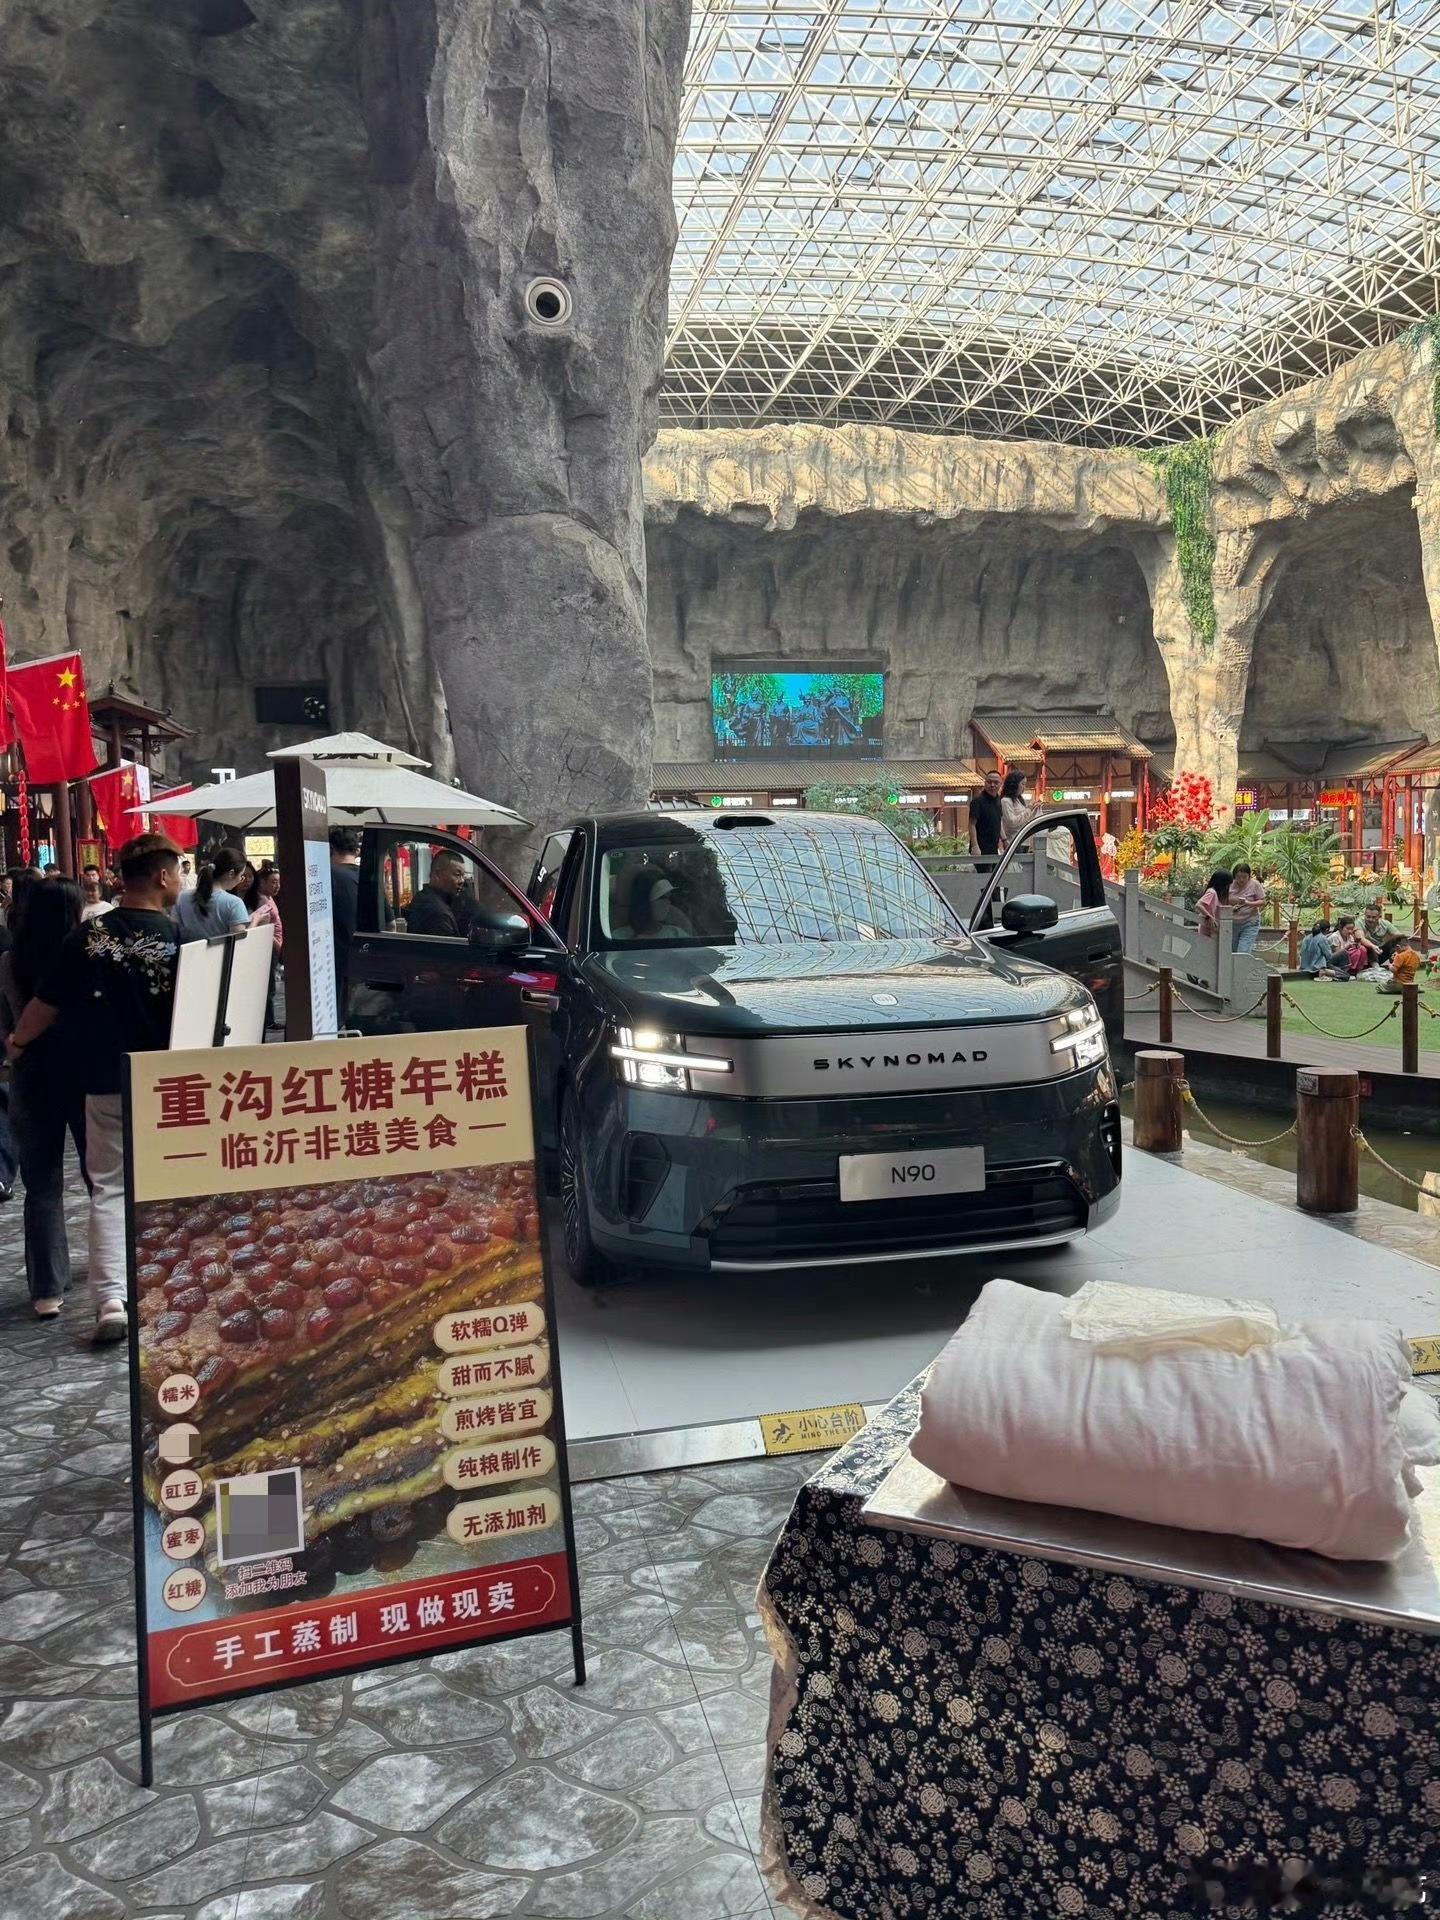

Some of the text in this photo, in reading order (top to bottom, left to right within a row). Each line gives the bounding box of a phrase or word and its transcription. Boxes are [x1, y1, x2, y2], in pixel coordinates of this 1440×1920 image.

[813, 1049, 989, 1071] SKYNOMAD
[153, 1050, 509, 1130] 重沟红糖年糕
[220, 1113, 458, 1170] 临沂非遗美食
[891, 1164, 936, 1184] N90
[450, 1312, 530, 1342] 软糯Q弹
[450, 1353, 536, 1387] 甜而不腻
[161, 1384, 195, 1404] 糯米
[454, 1399, 539, 1432] 煎烤皆宜
[799, 1410, 859, 1431] 小心台阶
[801, 1431, 822, 1440] MIND
[824, 1428, 840, 1437] THE
[457, 1446, 542, 1479] 纯粮制作
[165, 1480, 199, 1501] 豇豆
[463, 1503, 547, 1539] 无添加剂
[166, 1527, 201, 1549] 蜜枣
[238, 1557, 293, 1581] 扫二维码
[167, 1578, 202, 1600] 红糖
[225, 1570, 307, 1600] 添加我为朋友
[213, 1580, 516, 1670] 手工蒸制 现做现卖
